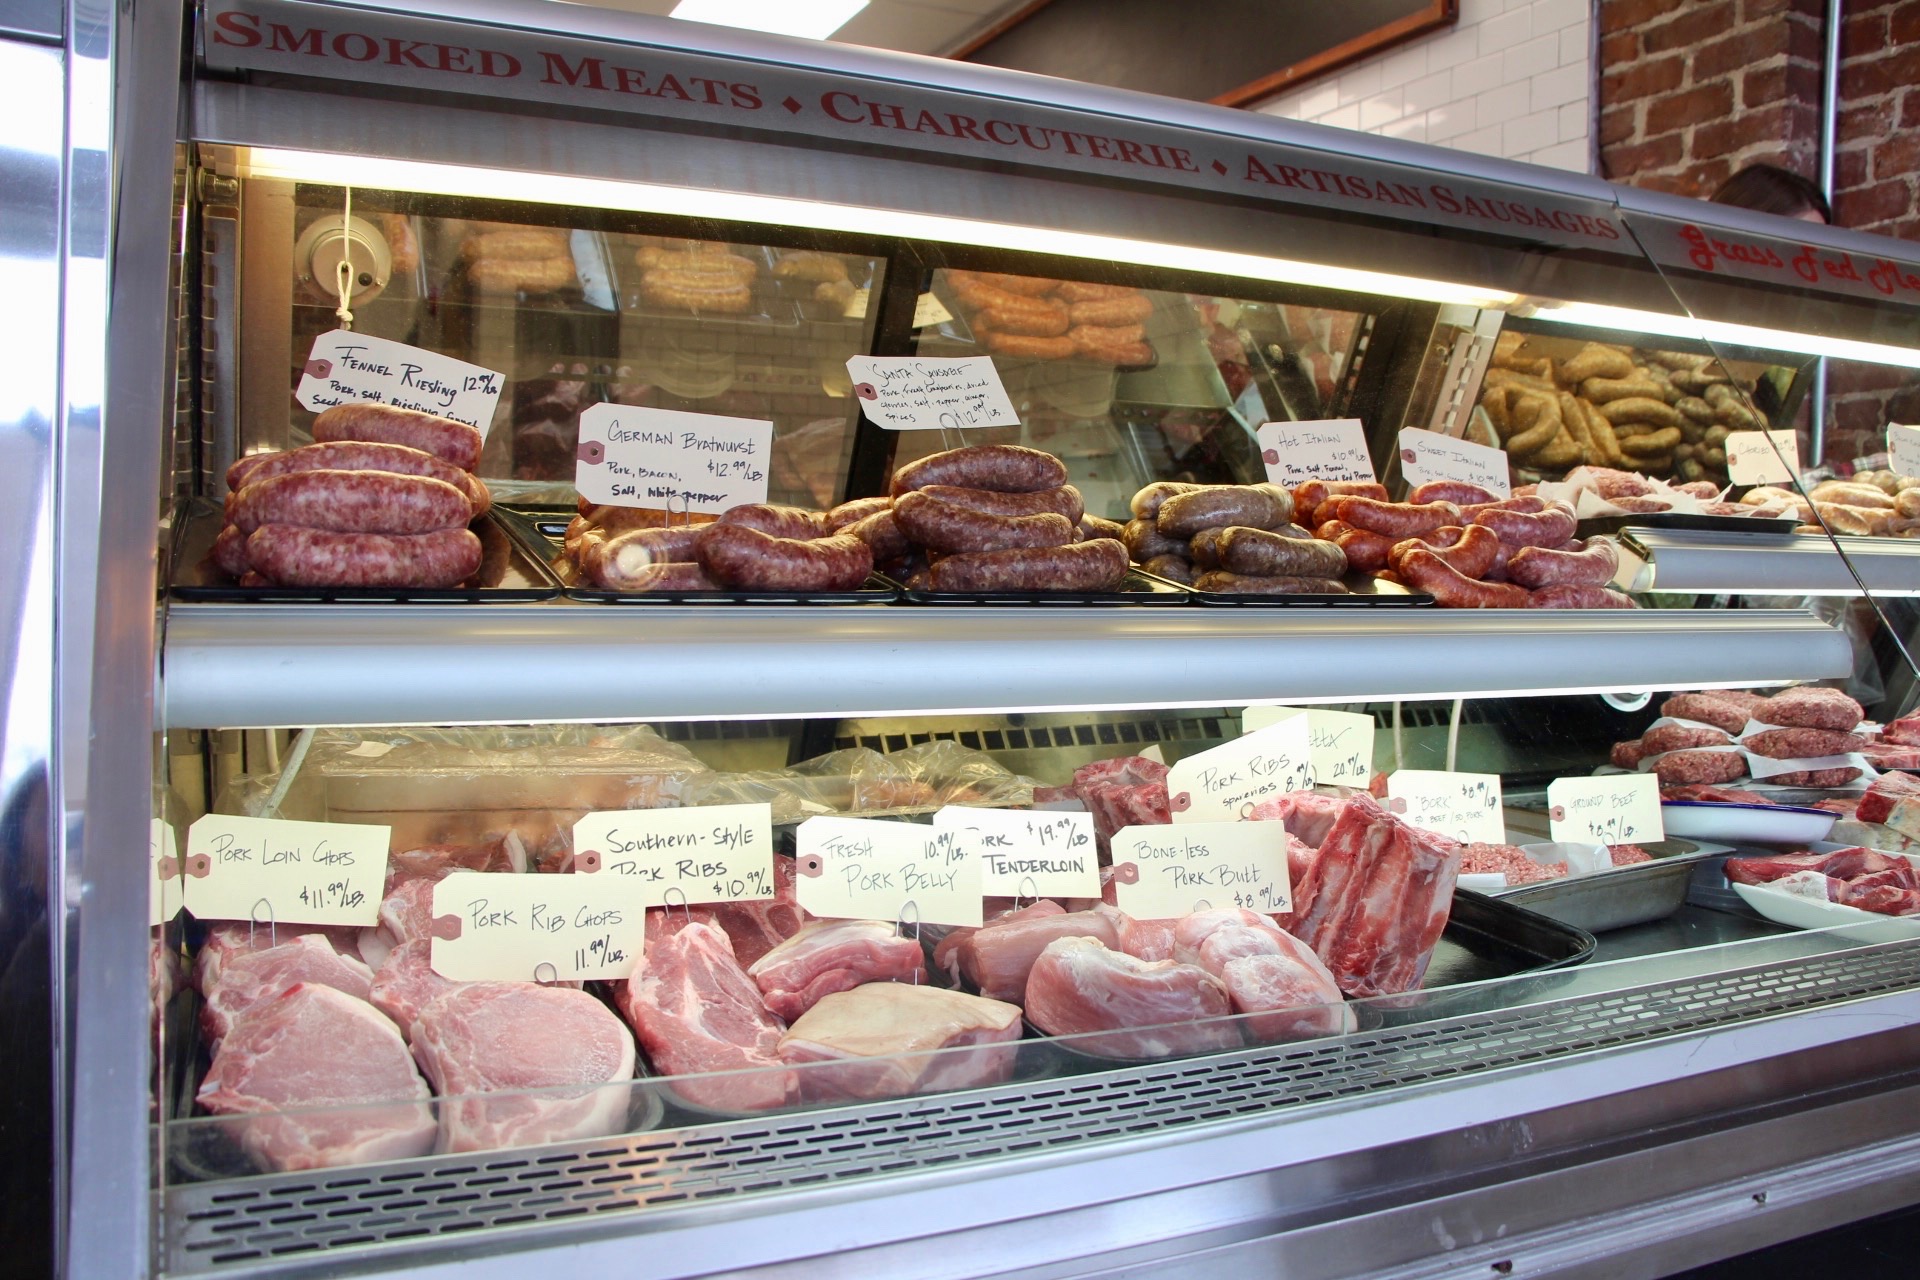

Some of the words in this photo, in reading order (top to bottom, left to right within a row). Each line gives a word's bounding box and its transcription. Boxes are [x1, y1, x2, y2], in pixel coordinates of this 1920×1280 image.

[213, 11, 522, 78] SMOKED
[538, 51, 763, 110] MEATS
[820, 91, 1200, 173] CHARCUTERIE
[1243, 154, 1428, 210] ARTISAN
[1428, 185, 1620, 241] SAUSAGES
[1679, 224, 1784, 272] Grass
[1792, 245, 1862, 283] Fed
[608, 419, 673, 444] GERMAN
[1197, 766, 1243, 794] PORK
[1248, 754, 1291, 778] RIBS
[1611, 790, 1638, 808] BEEF
[211, 833, 252, 864] PORK
[262, 838, 301, 866] LOIN
[312, 840, 355, 866] CHOPS
[821, 834, 873, 860] FRESH
[676, 859, 727, 879] RIBS
[982, 853, 1085, 876] TENDERLOIN
[1162, 865, 1213, 889] PORK
[1210, 863, 1261, 887] Butt
[841, 863, 894, 898] PORK
[899, 863, 957, 893] BELLY
[467, 898, 518, 930] PORK
[531, 903, 566, 933] RIB
[574, 905, 623, 929] CHOPS
